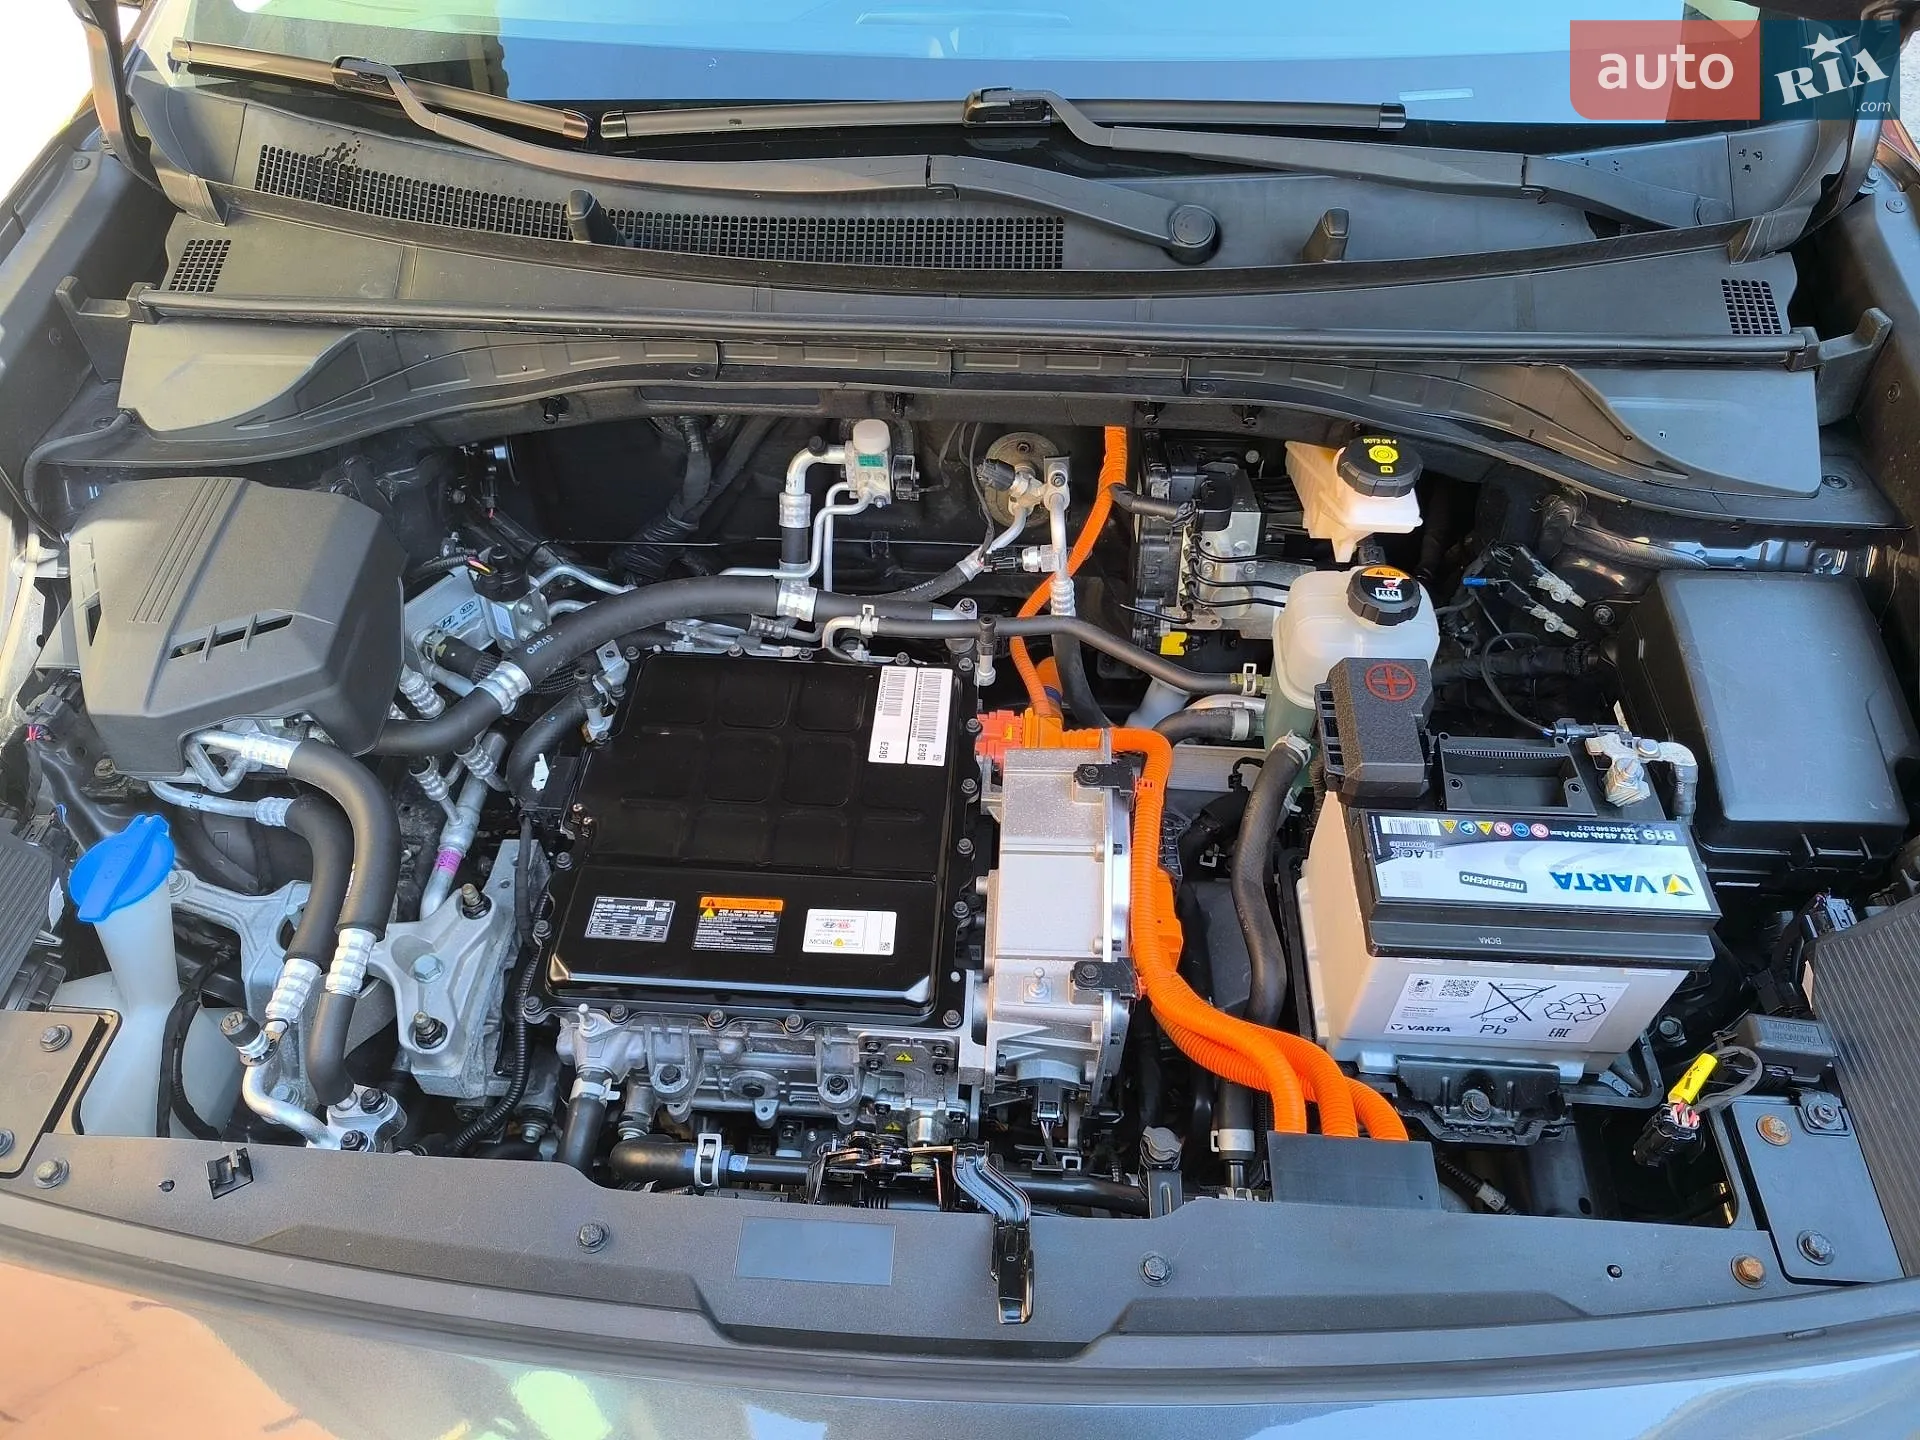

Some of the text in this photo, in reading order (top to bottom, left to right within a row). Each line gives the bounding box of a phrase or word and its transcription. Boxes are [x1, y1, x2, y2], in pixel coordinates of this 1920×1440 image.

[1620, 832, 1639, 840] 12V
[1642, 828, 1678, 841] B19
[1390, 848, 1444, 859] BLACK
[1461, 874, 1524, 891] ПЕРЕВІРЕНО
[1550, 871, 1659, 894] VARTA
[1407, 1025, 1452, 1033] VARTA
[1479, 1024, 1508, 1035] Pb
[1548, 1028, 1572, 1038] EAC
